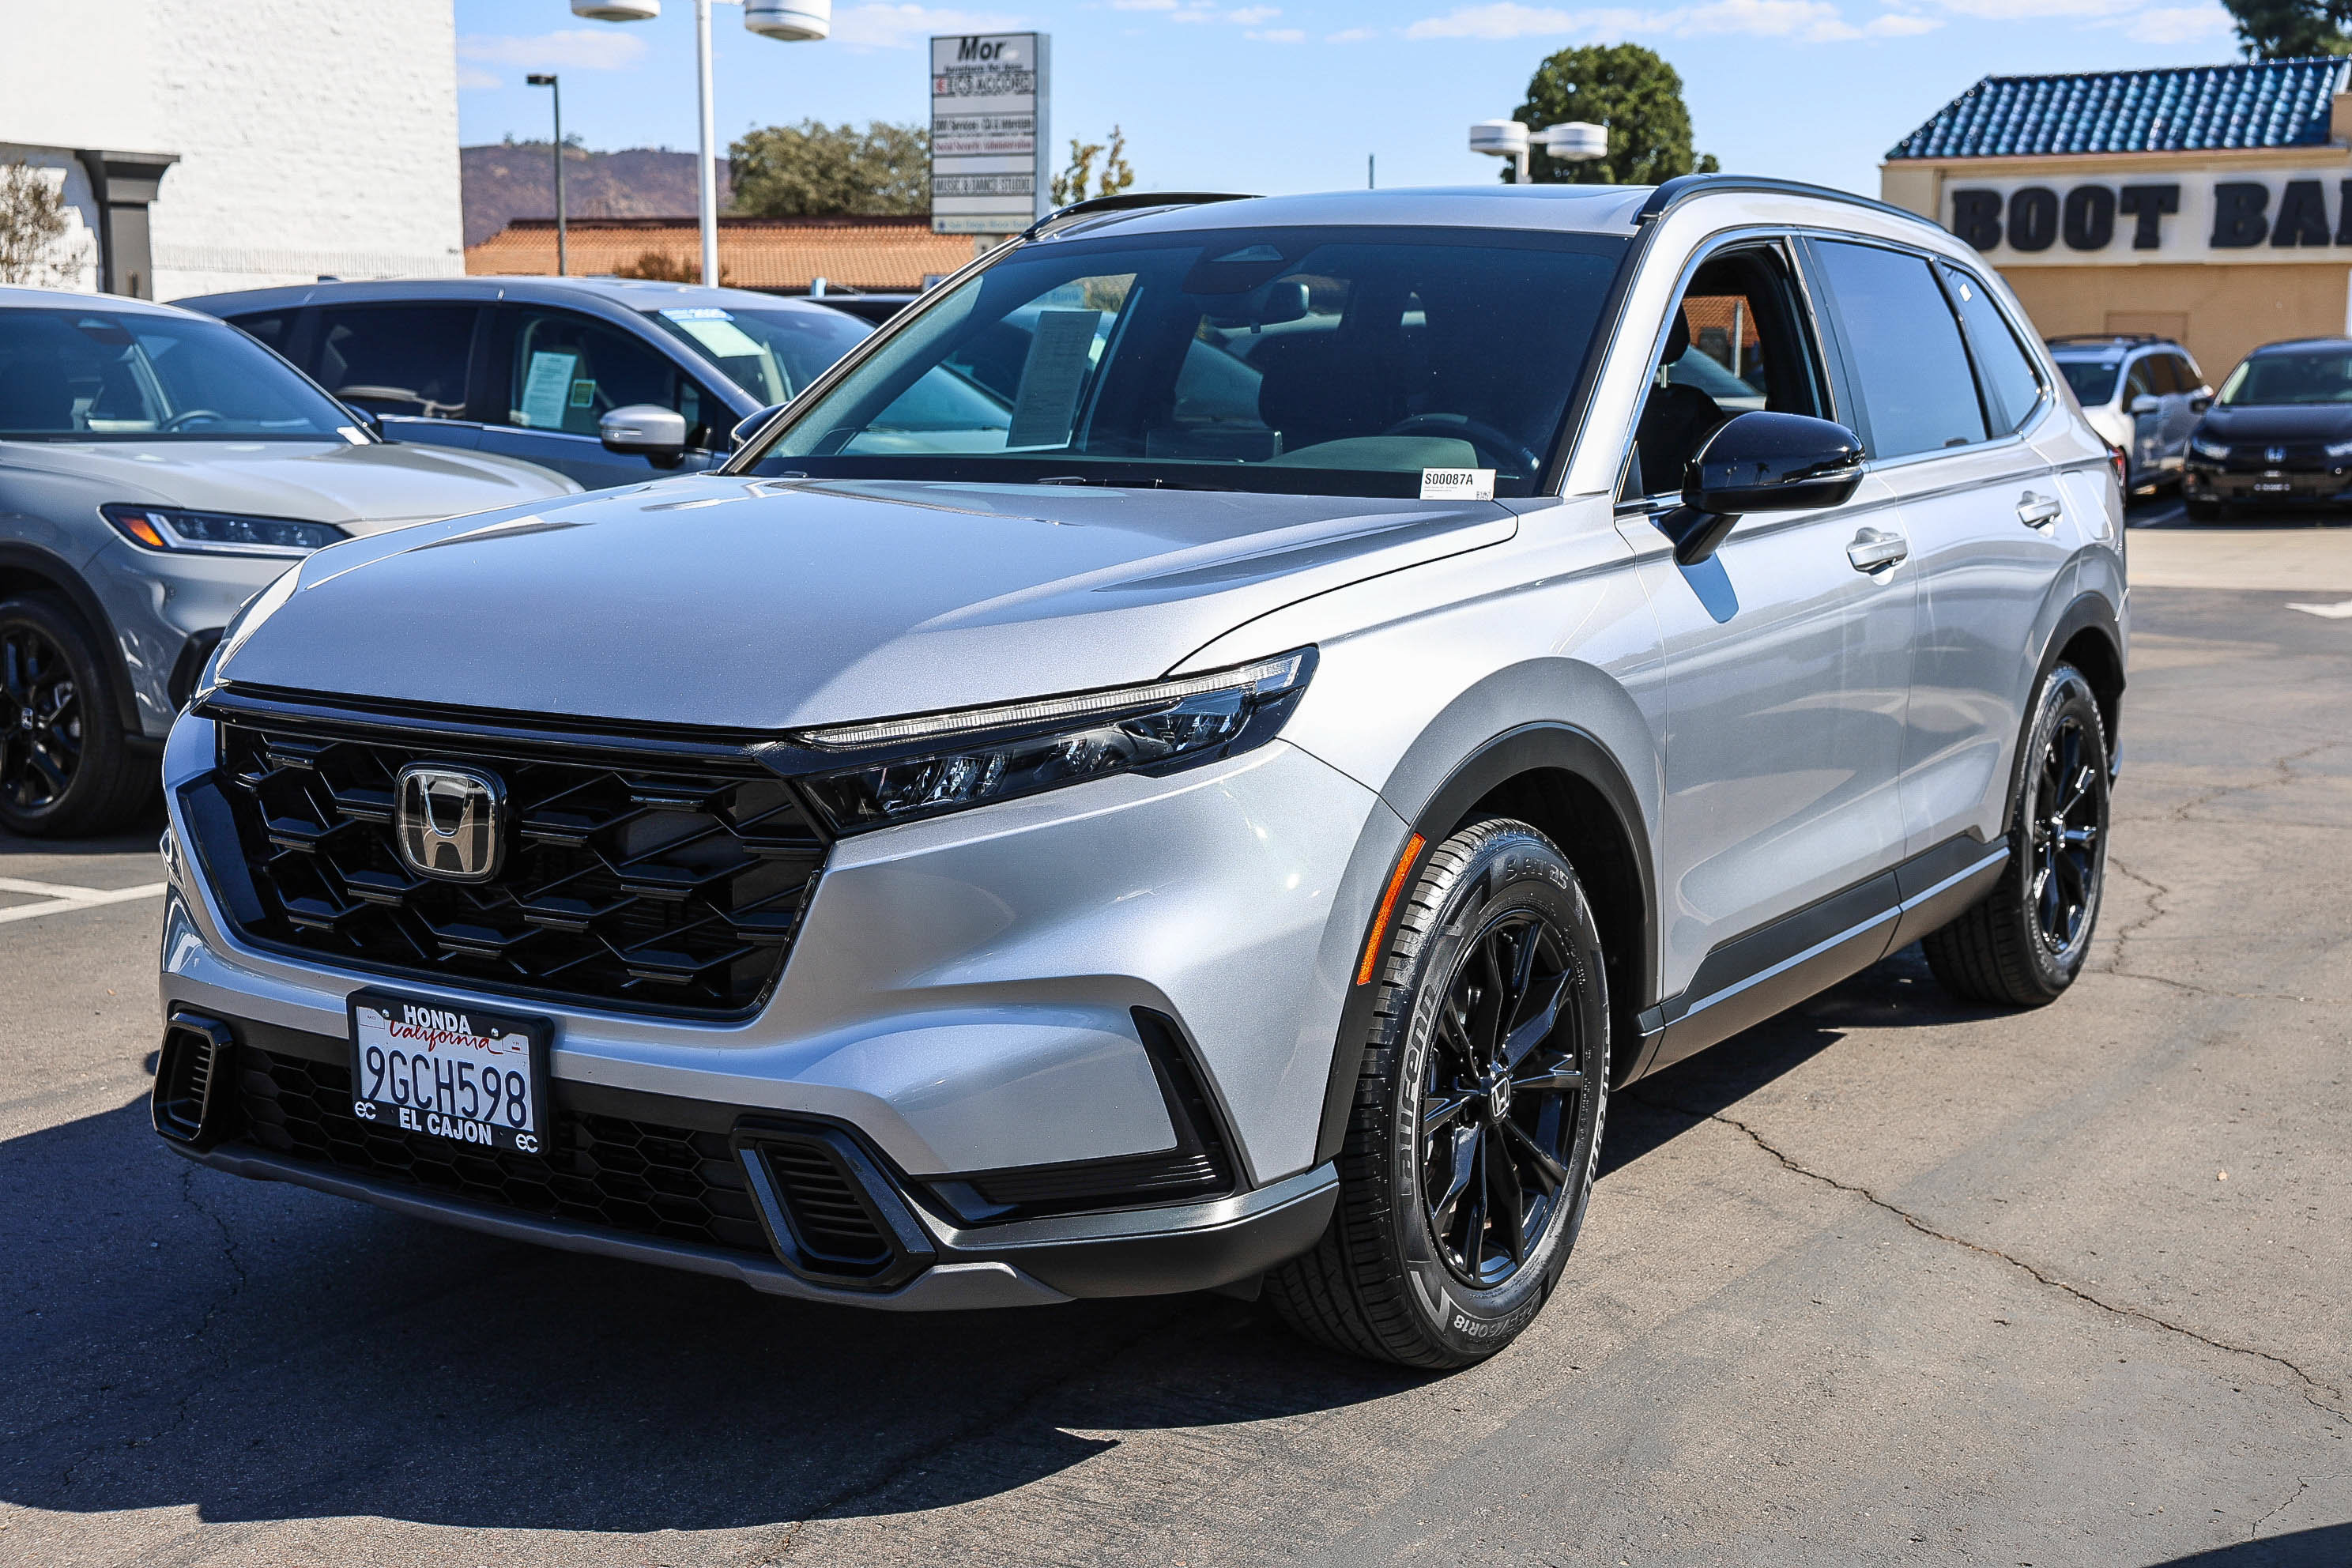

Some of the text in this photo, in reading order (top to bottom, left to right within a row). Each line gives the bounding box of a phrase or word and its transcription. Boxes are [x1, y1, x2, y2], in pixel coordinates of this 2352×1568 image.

[957, 36, 1007, 61] Mor
[1952, 179, 2352, 251] BOOT BA
[1425, 473, 1473, 484] S00087A
[403, 1004, 472, 1035] HONDA
[390, 1020, 504, 1054] California
[366, 1046, 527, 1129] 9GCH598
[399, 1107, 492, 1145] EL CAJON
